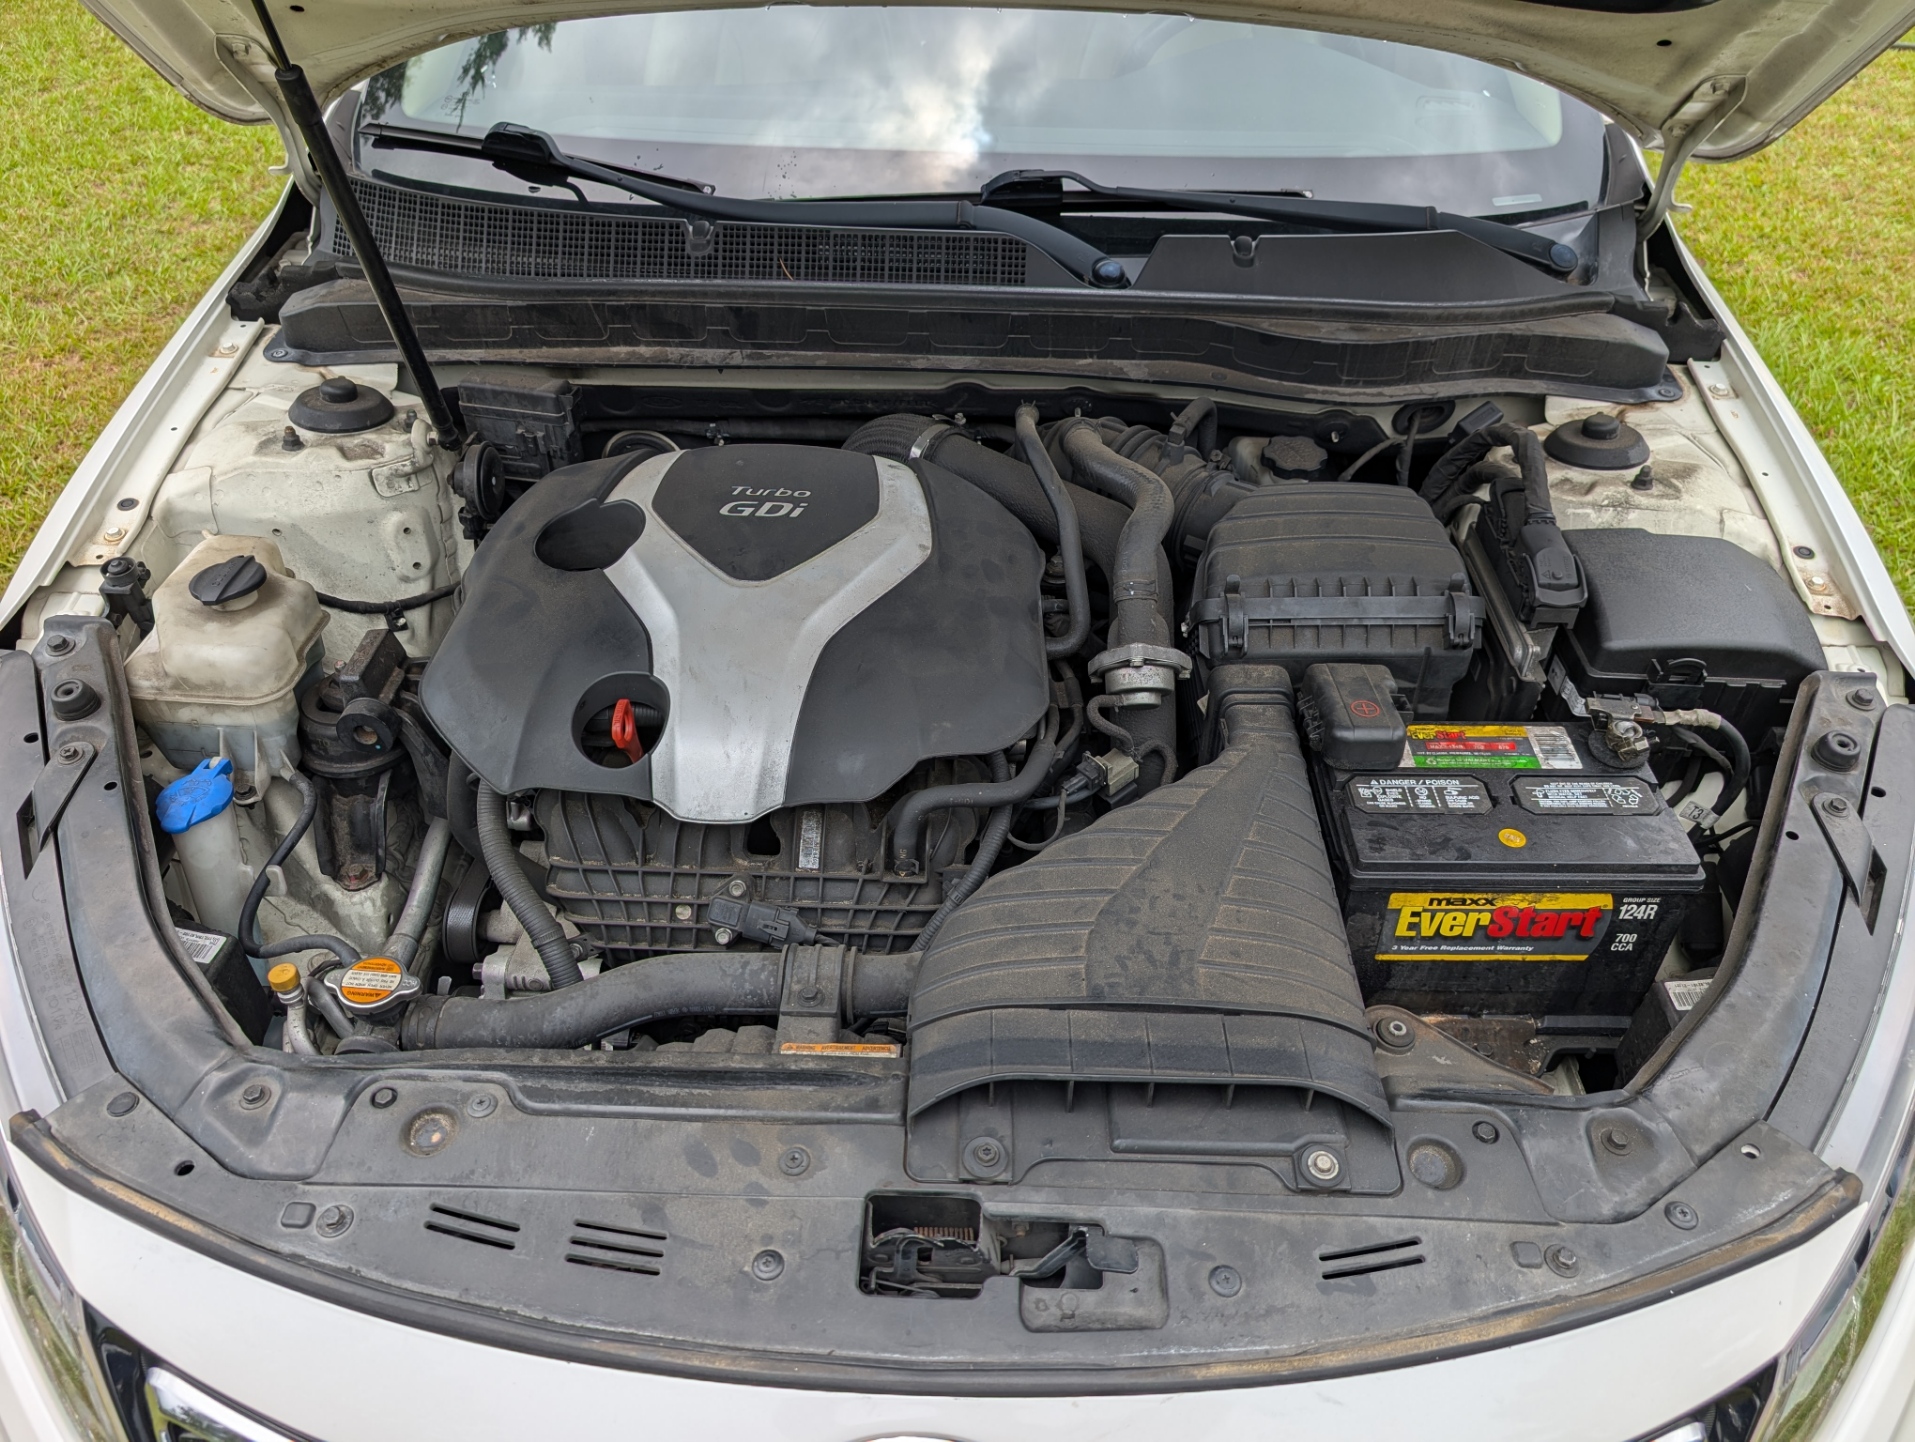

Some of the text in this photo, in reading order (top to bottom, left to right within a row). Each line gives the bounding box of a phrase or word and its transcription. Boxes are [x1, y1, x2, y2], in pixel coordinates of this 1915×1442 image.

[731, 485, 812, 498] Turbo
[719, 501, 809, 518] GDi
[1689, 805, 1704, 820] T3
[1428, 897, 1499, 907] maxx
[1618, 904, 1658, 920] 124R
[1395, 904, 1602, 939] EverStart
[1615, 933, 1638, 943] 700
[1610, 943, 1633, 951] CCA
[346, 990, 375, 998] WARNING
